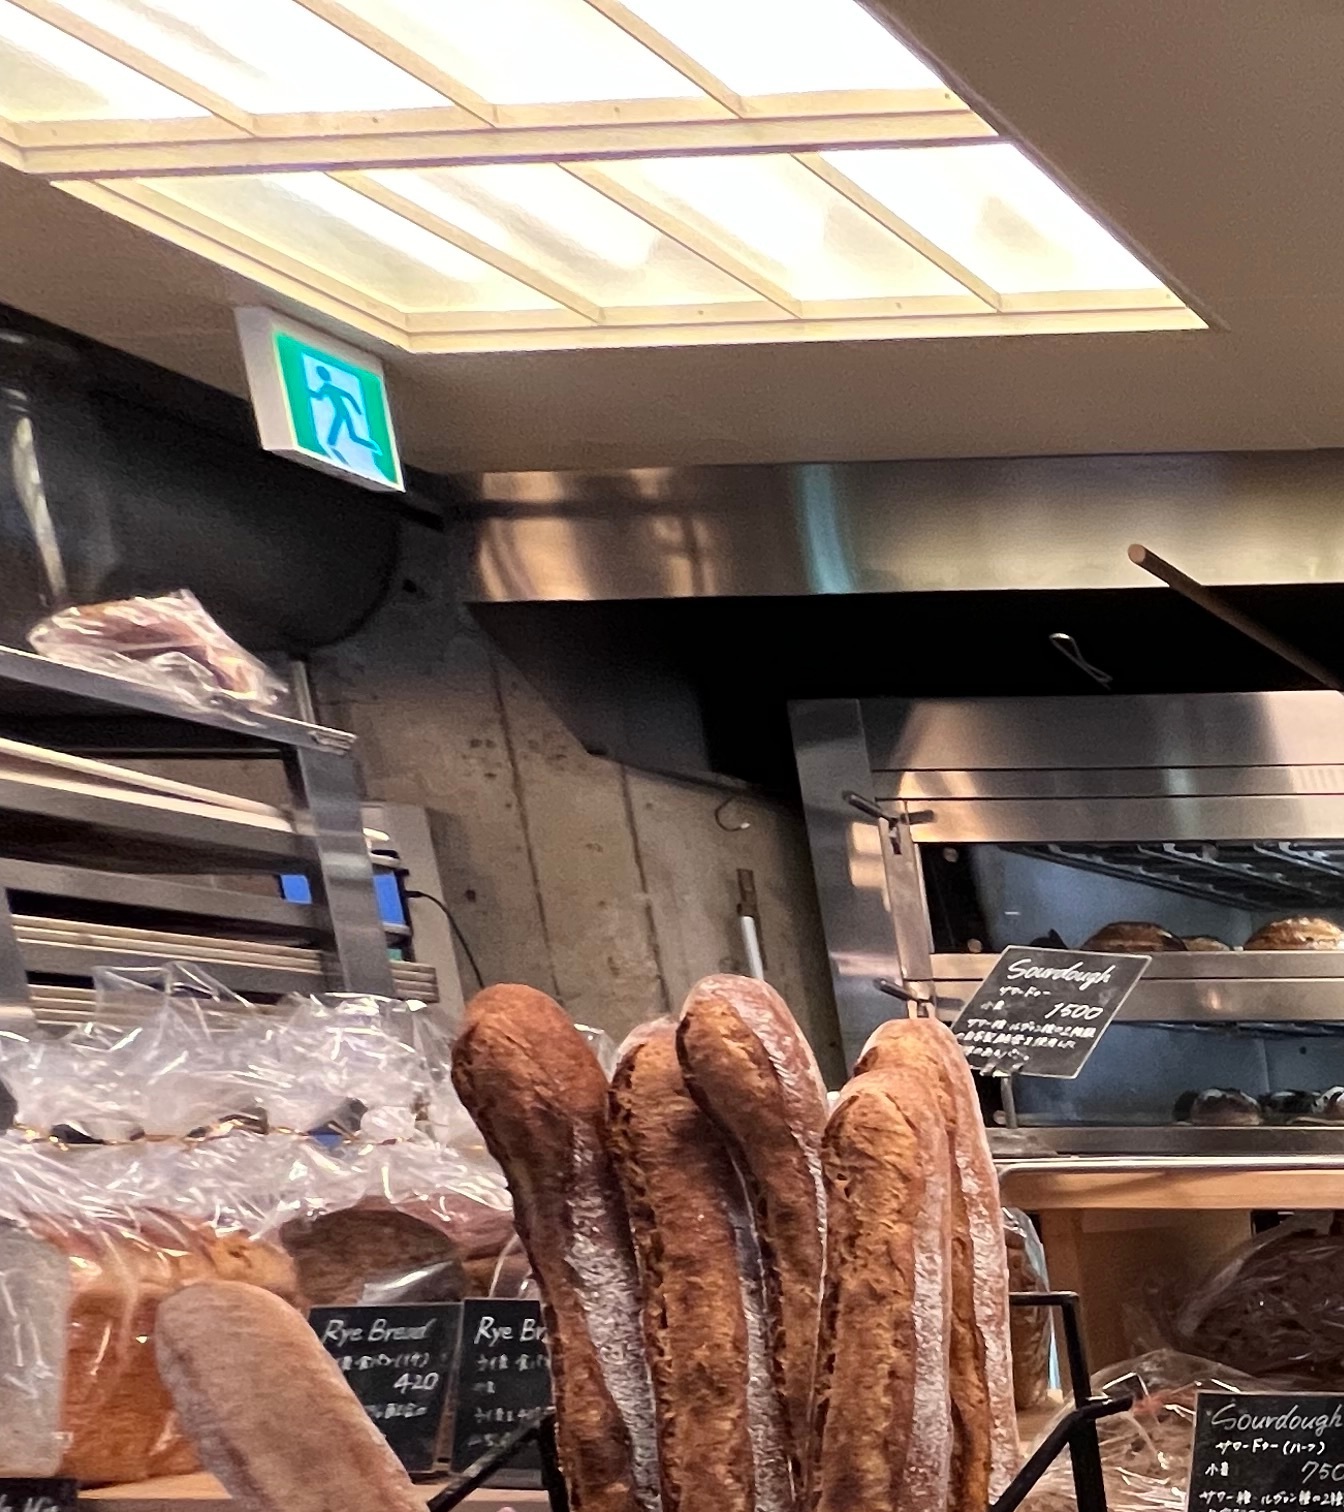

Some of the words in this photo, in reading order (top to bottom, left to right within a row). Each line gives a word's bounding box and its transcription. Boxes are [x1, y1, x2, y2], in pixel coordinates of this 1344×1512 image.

[1007, 958, 1117, 991] Sourdough
[1045, 1002, 1104, 1020] 1500
[323, 1319, 363, 1347] Rye
[474, 1316, 514, 1346] Rye
[394, 1372, 440, 1394] 420
[1211, 1403, 1344, 1437] Sourdough
